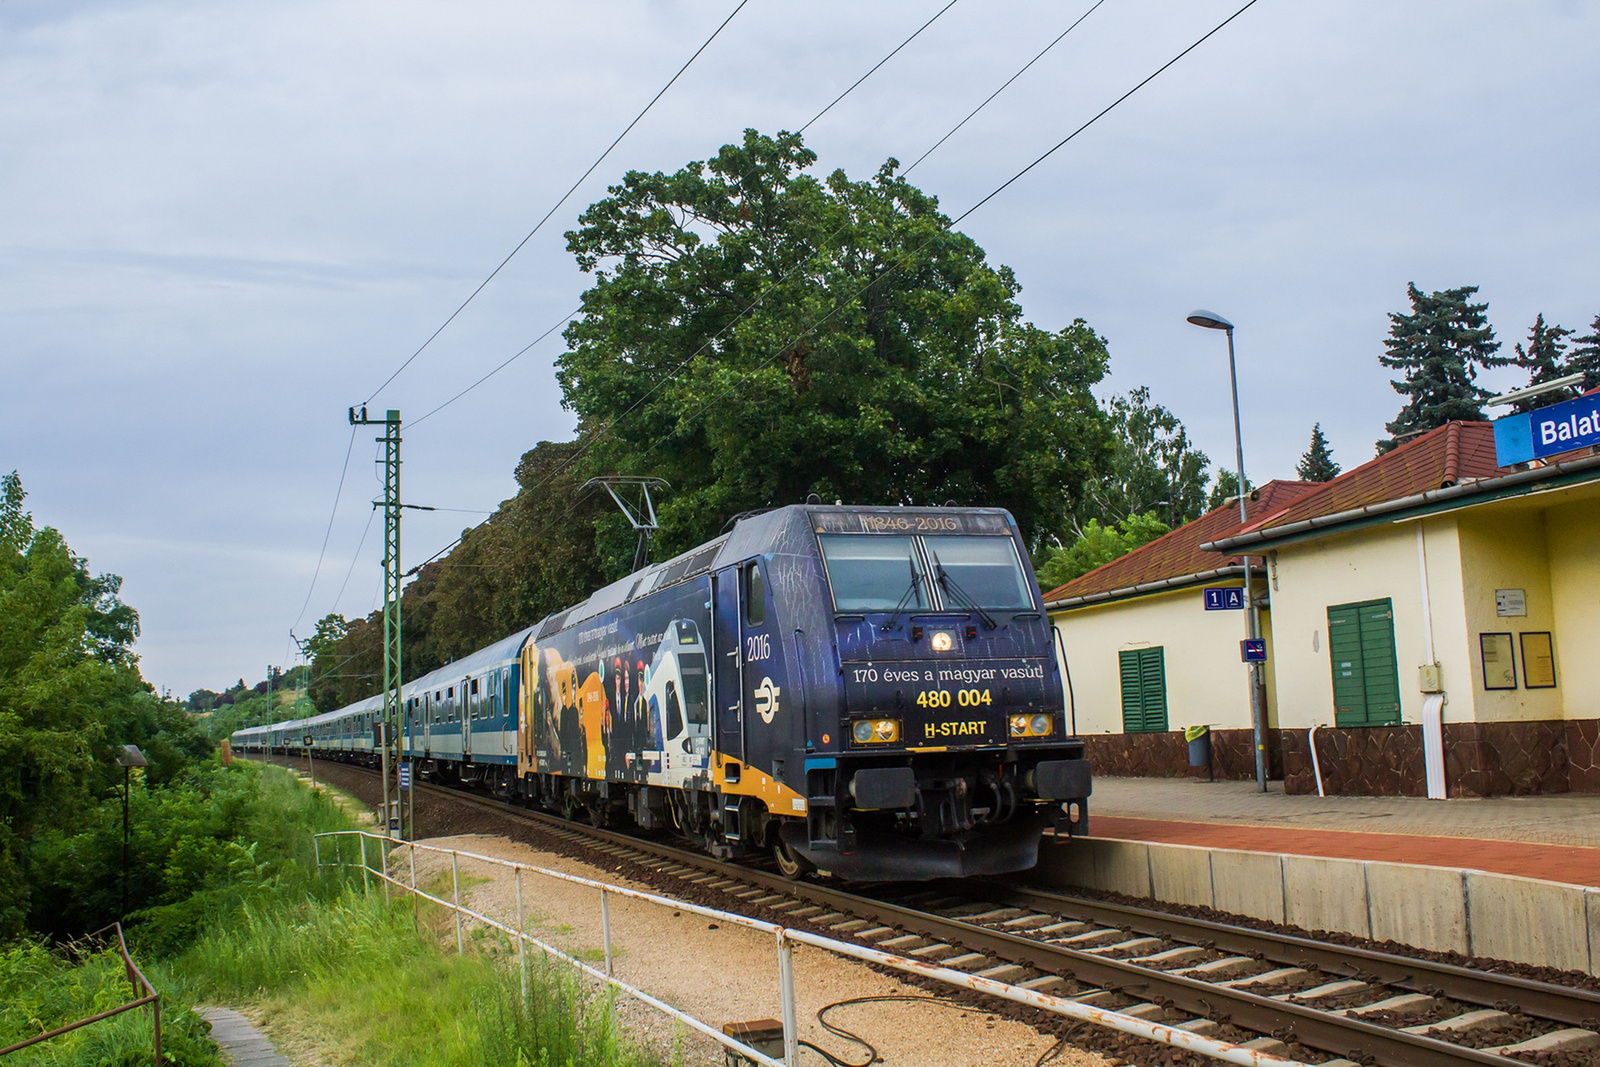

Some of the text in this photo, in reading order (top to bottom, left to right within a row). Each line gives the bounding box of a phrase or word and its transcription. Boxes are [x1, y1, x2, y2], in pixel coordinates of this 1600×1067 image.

[1540, 409, 1600, 446] Balat
[867, 516, 957, 531] 1846-2016
[1211, 591, 1239, 603] 1 A
[747, 633, 771, 662] 2016
[853, 665, 1044, 684] 170 éves a magyar vasút!
[916, 688, 993, 708] 480 004
[924, 721, 987, 738] H-START
